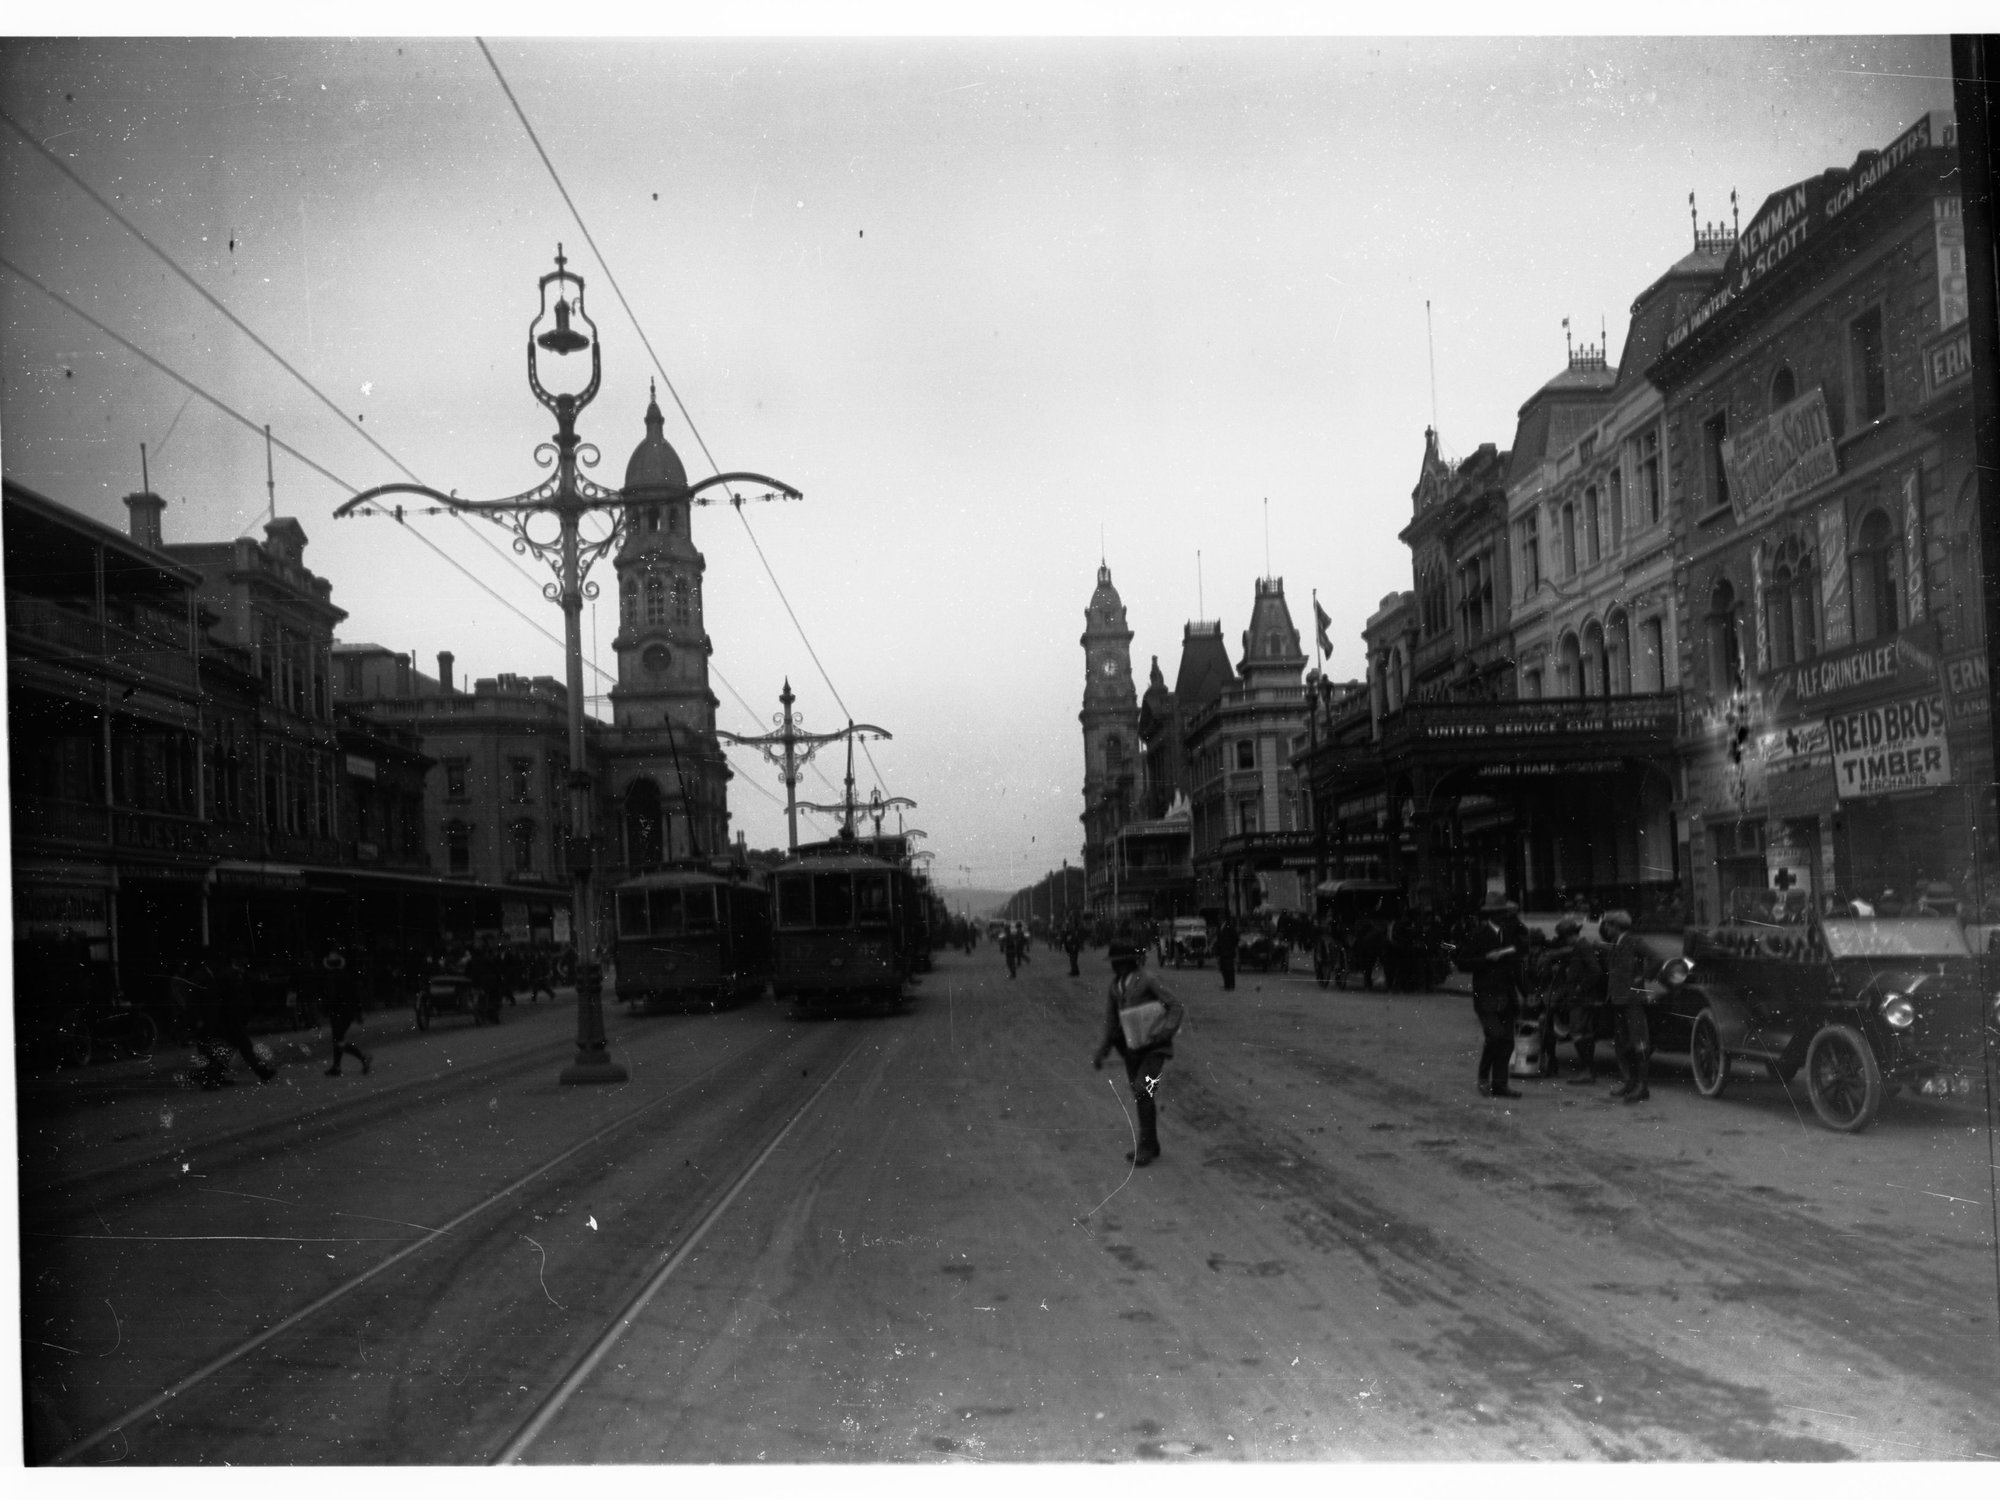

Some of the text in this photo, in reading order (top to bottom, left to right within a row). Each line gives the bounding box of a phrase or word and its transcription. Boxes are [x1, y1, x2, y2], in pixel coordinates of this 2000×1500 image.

[1825, 180, 1855, 219] SIGN
[1858, 121, 1930, 195] PAINTERS
[1739, 183, 1807, 263] NEWMAN
[1755, 216, 1809, 279] SCOTT
[1495, 721, 1557, 734] SERVICE
[1566, 719, 1603, 732] CLUB
[1612, 716, 1657, 730] HOTEL
[1832, 709, 1882, 755] REID
[1843, 745, 1942, 785] TIMBER
[1859, 771, 1928, 792] MERCHANTS
